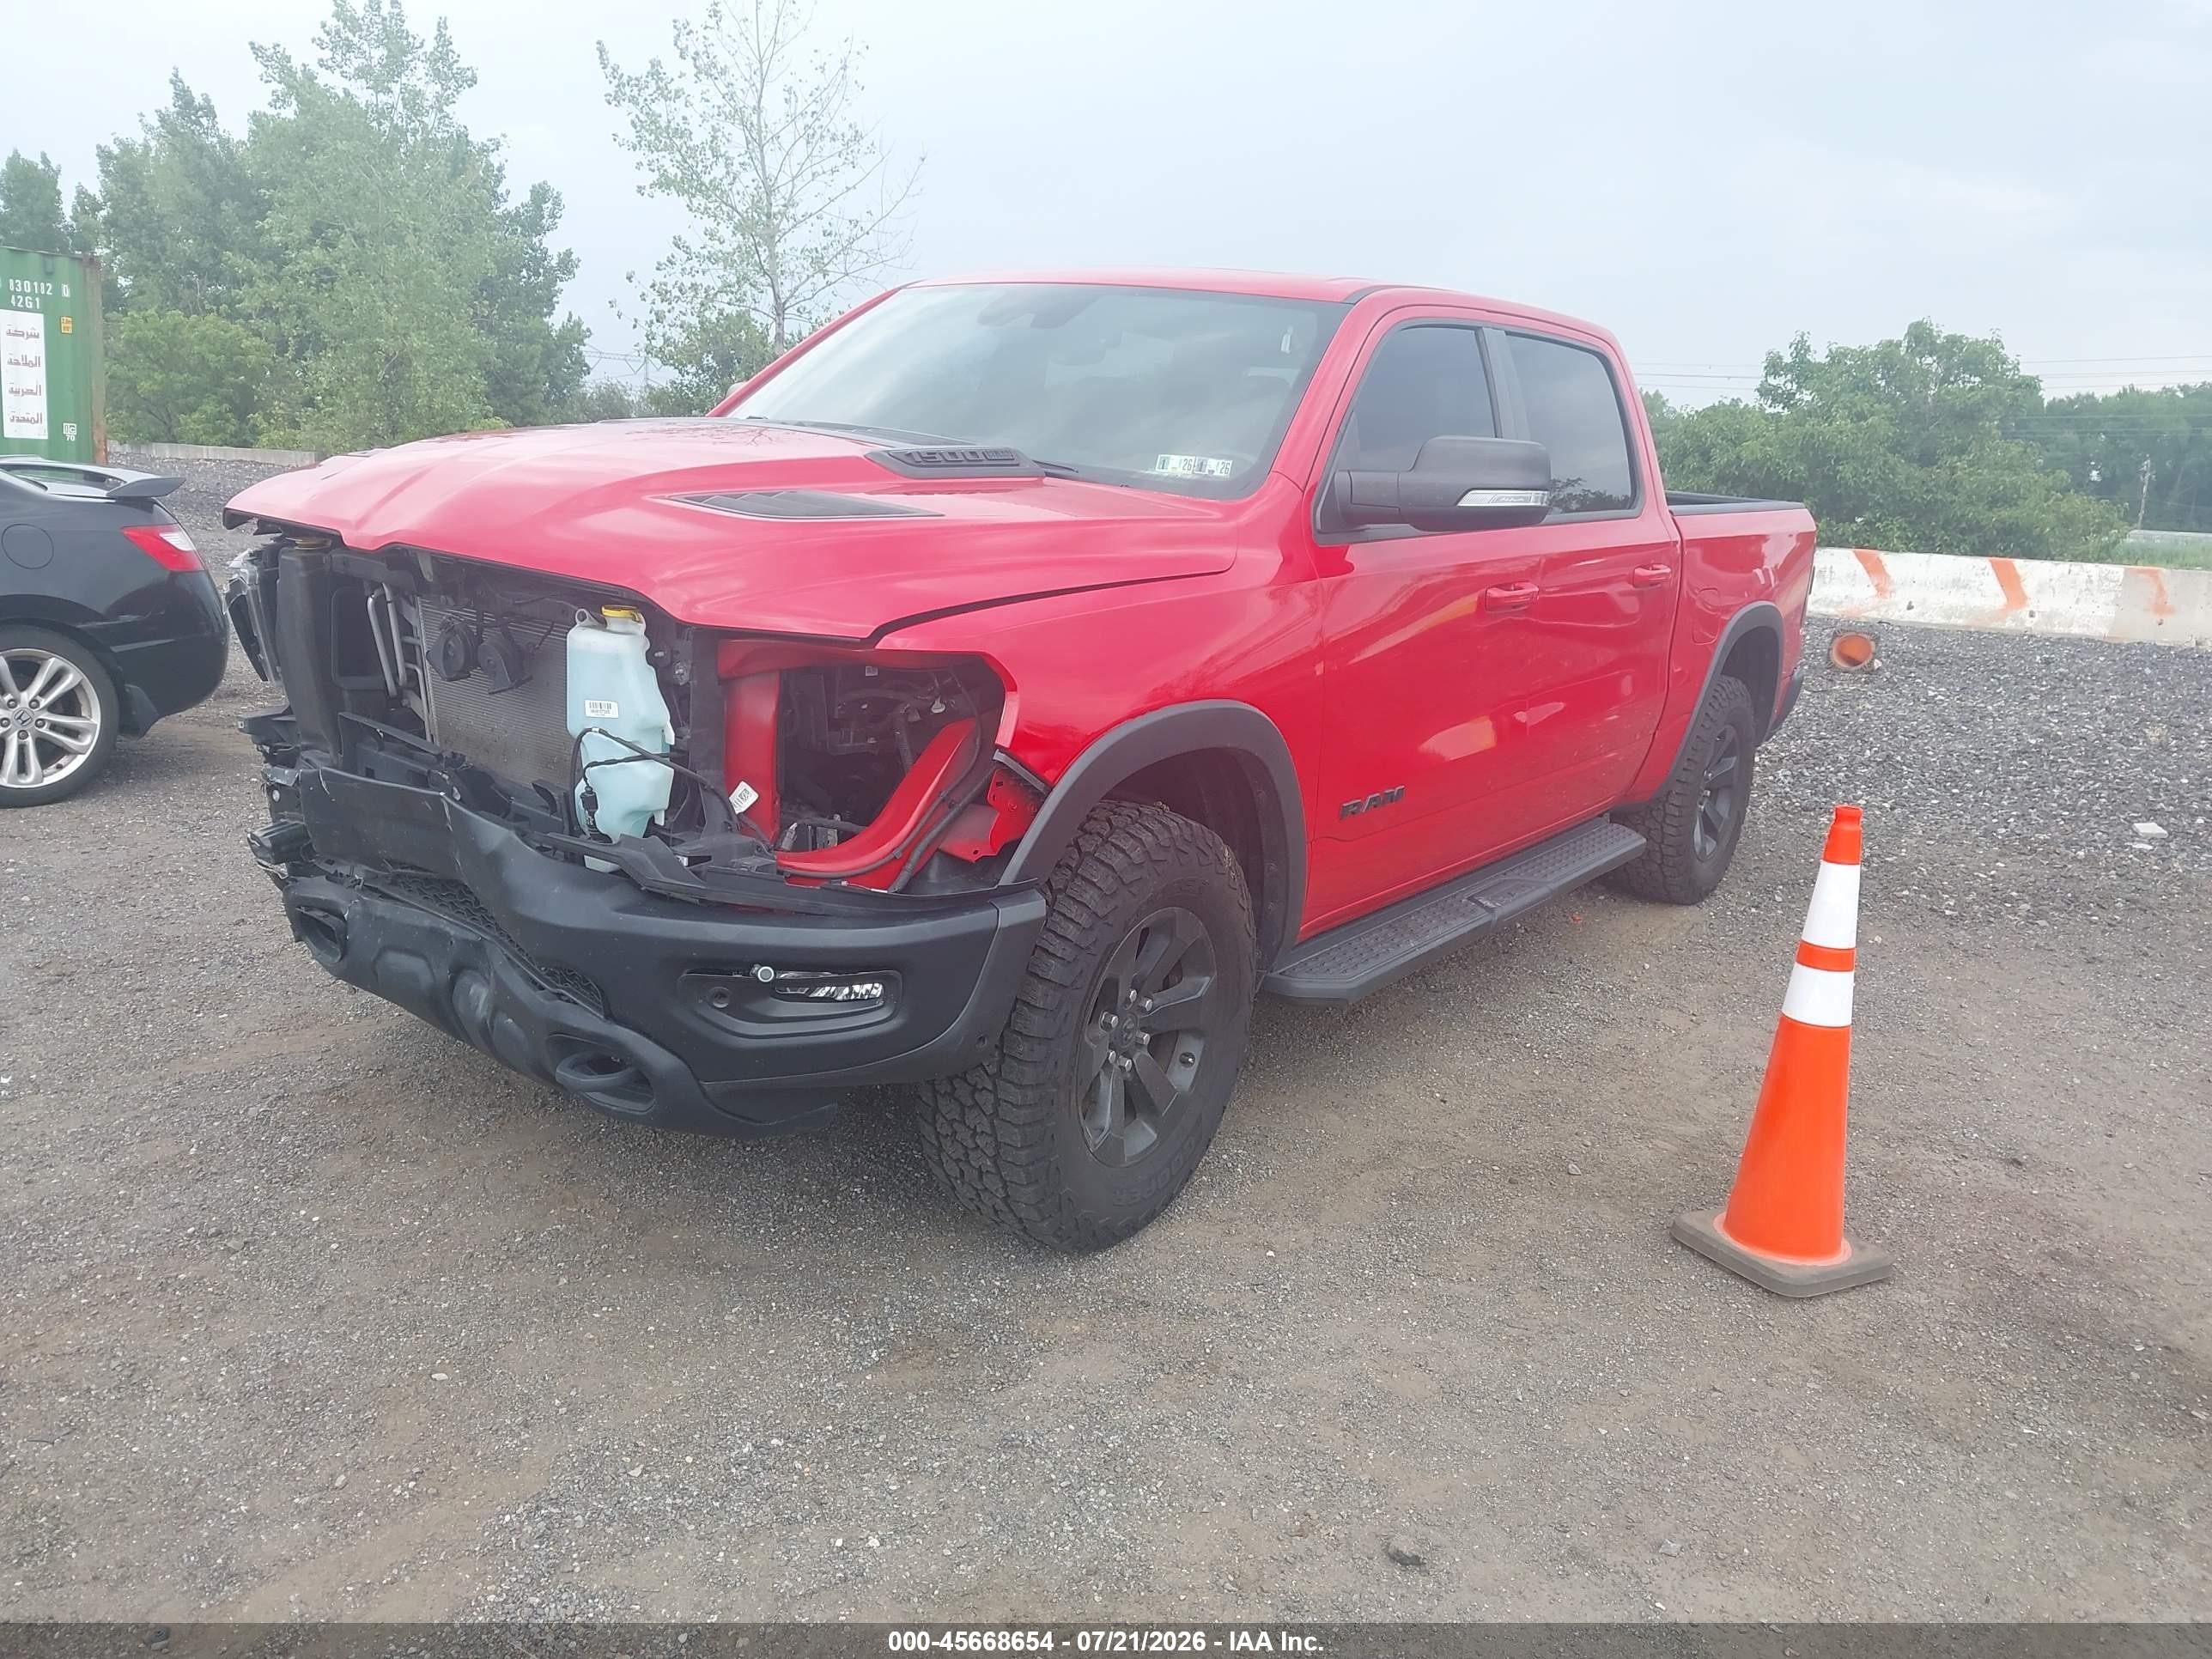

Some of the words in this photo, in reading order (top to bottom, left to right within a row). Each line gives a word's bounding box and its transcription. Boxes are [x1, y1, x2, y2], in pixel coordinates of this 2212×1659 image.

[10, 295, 40, 309] 42G1
[6, 324, 40, 340] شركة
[7, 352, 40, 368] الملاحة
[9, 382, 41, 397] العربية
[9, 410, 42, 424] المتحدة
[904, 450, 983, 464] 1500
[1182, 459, 1193, 471] 26
[1219, 461, 1231, 474] 26
[1340, 785, 1406, 820] RAM
